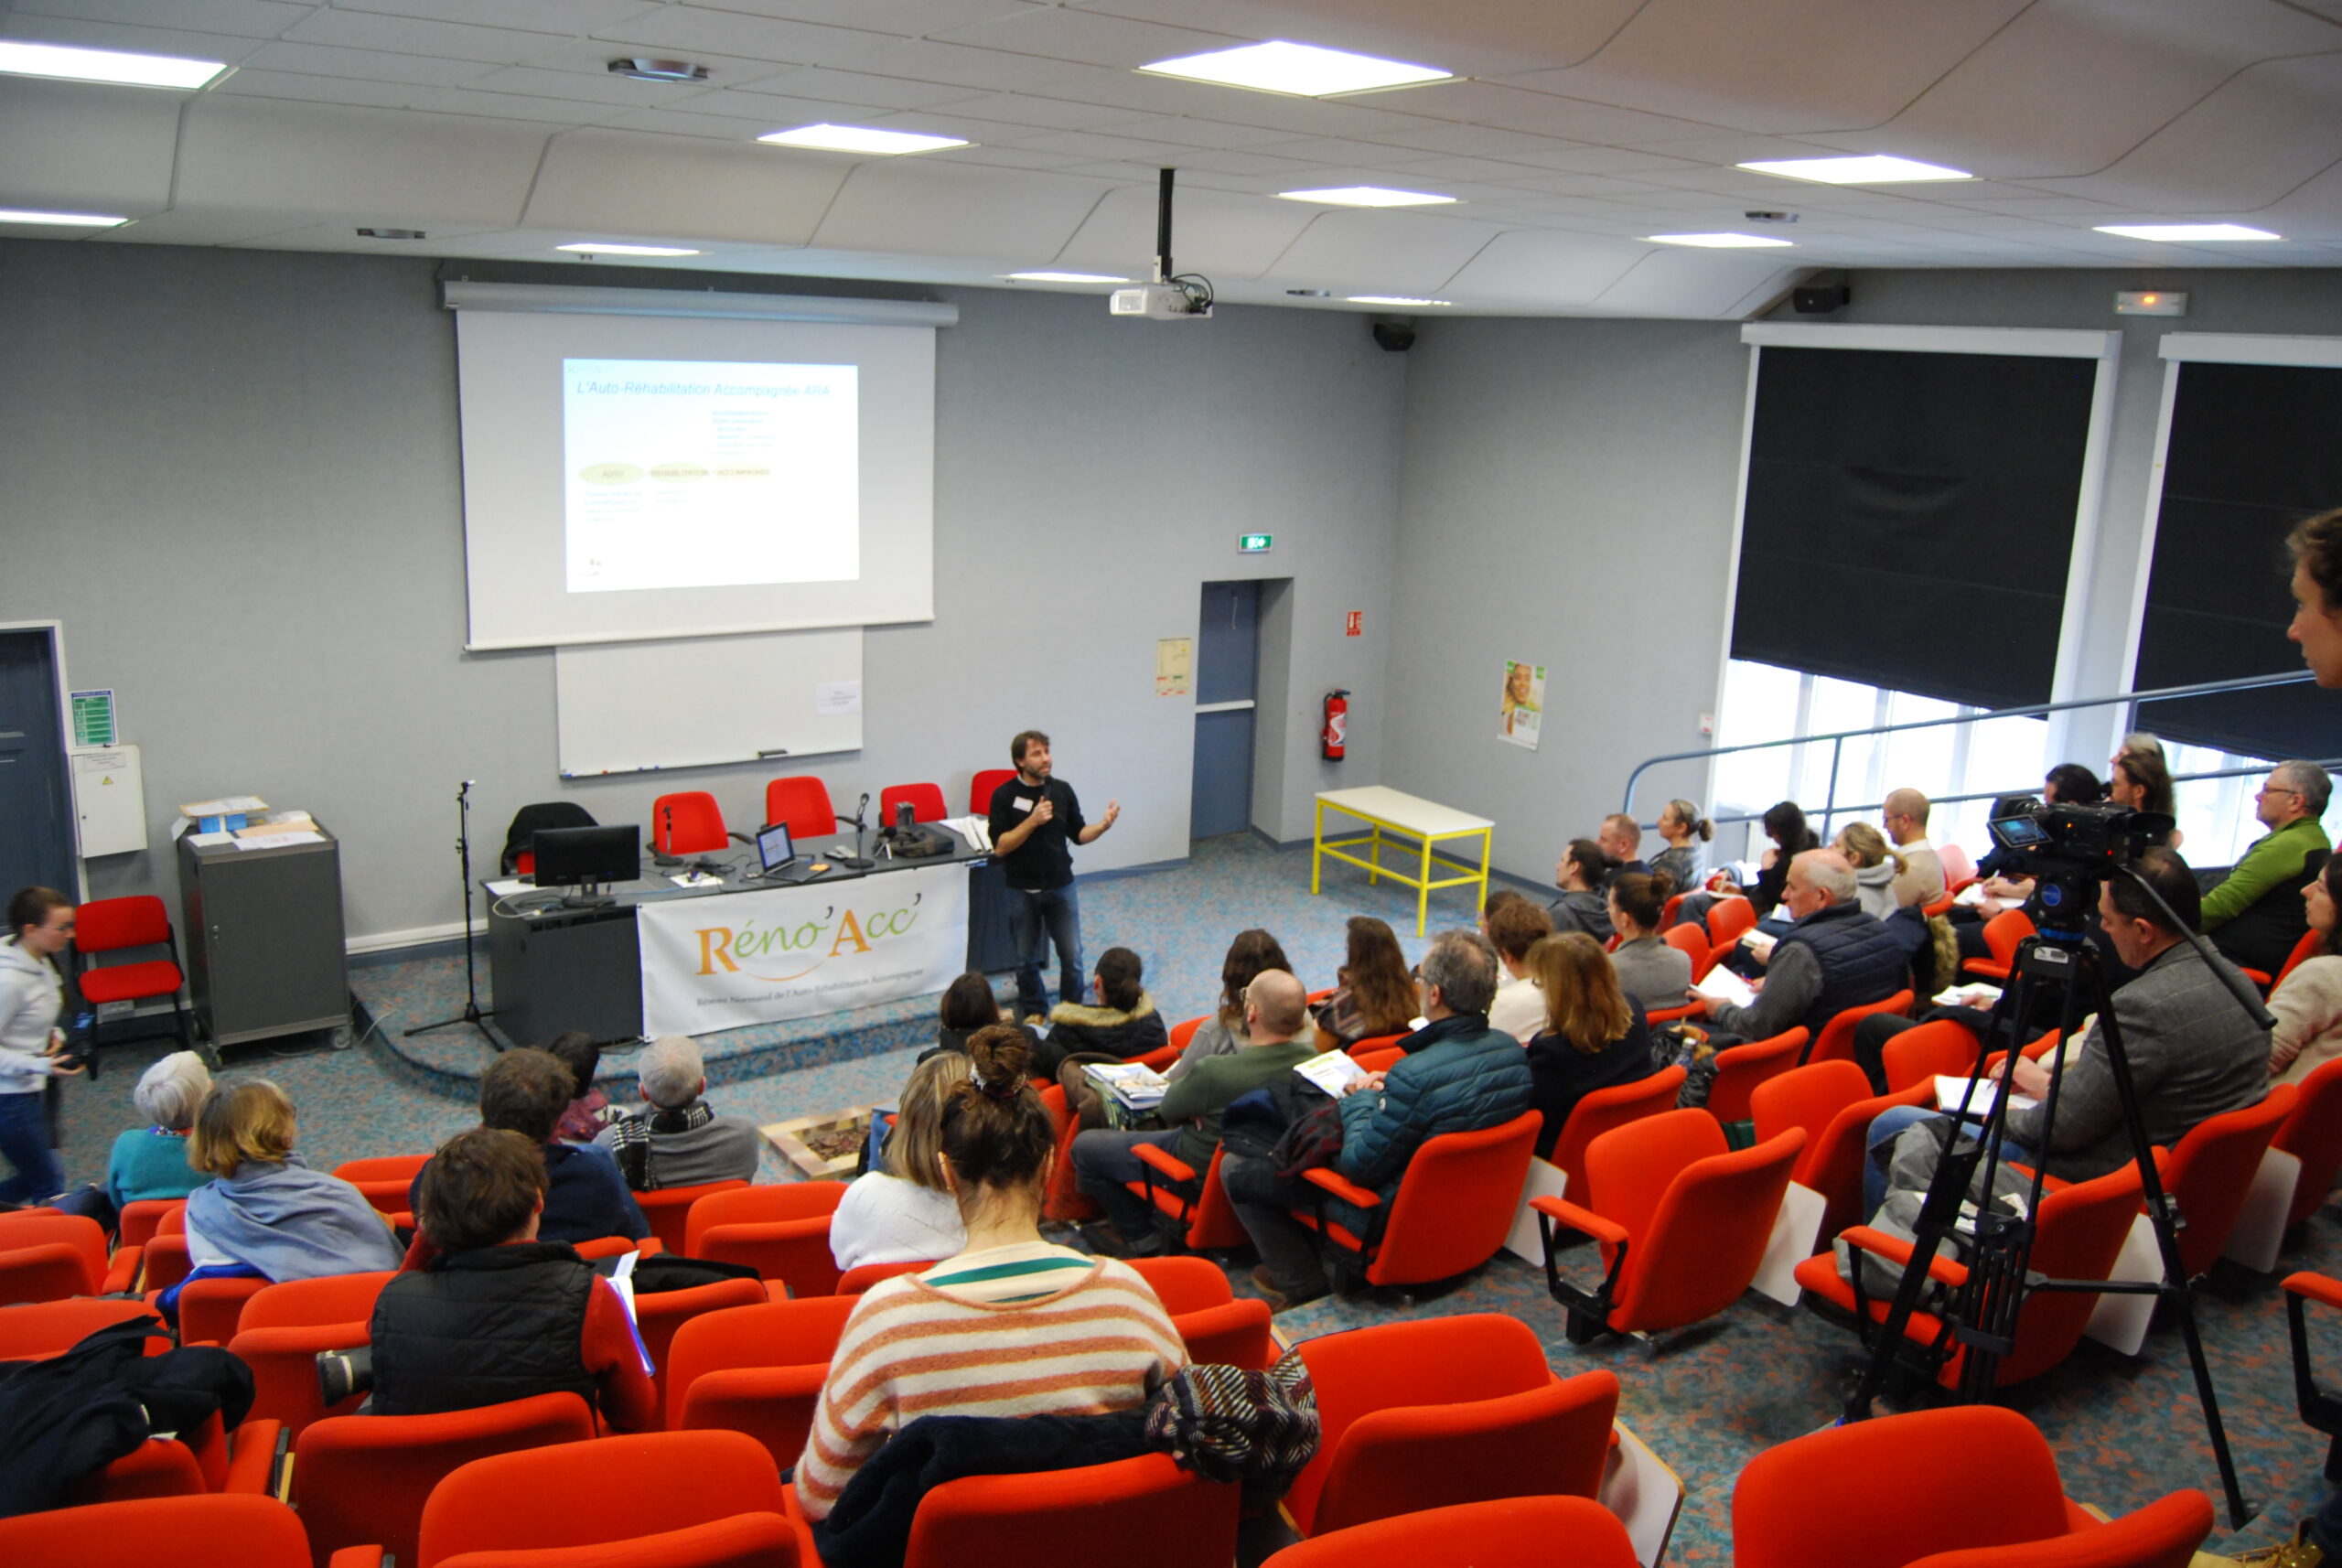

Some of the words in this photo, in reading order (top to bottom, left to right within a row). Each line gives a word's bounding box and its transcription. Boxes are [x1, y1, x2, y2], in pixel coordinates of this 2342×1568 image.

[804, 383, 830, 396] ARA
[730, 993, 772, 1004] Normand
[774, 991, 785, 1000] de
